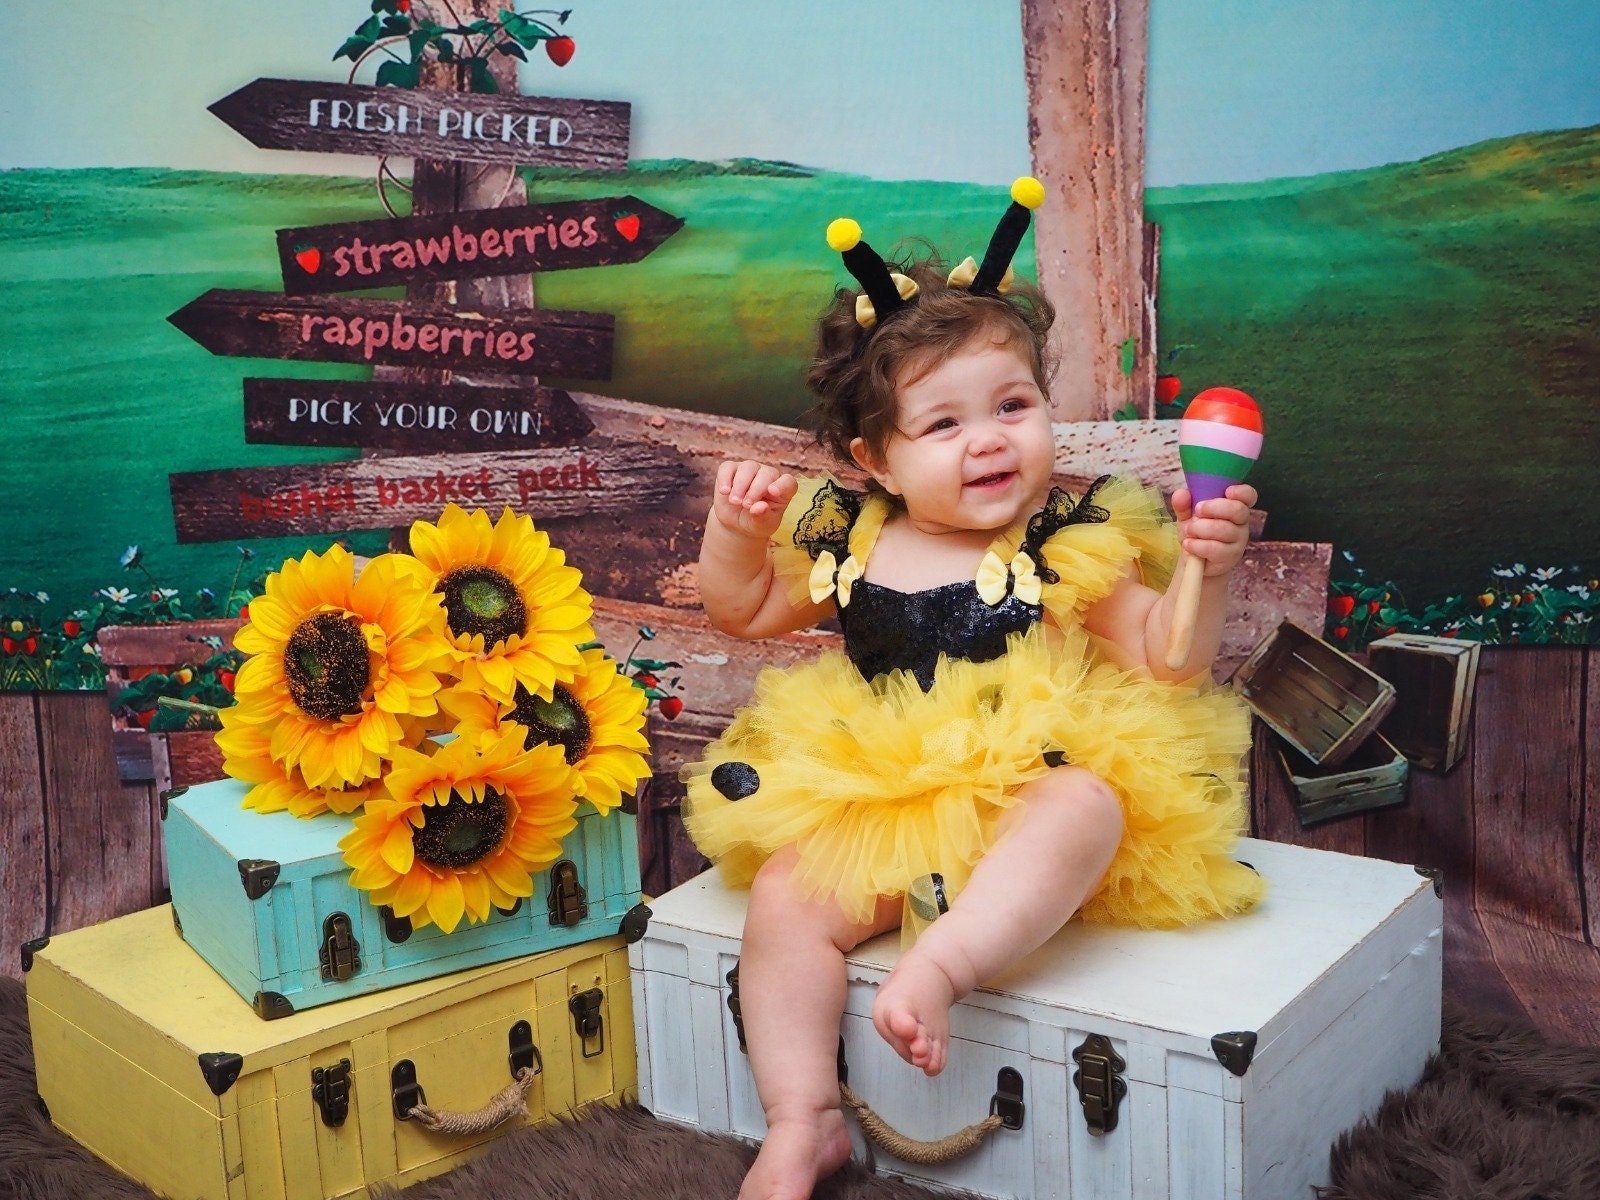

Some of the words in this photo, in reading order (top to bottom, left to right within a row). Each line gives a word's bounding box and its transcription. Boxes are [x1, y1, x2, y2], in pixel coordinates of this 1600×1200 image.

[310, 99, 421, 133] FRESH
[438, 108, 574, 147] PICKED
[333, 215, 599, 276] strawberries
[302, 314, 536, 361] raspberries
[288, 398, 364, 425] PICK
[377, 402, 458, 432] YOUR
[470, 407, 543, 436] OWN
[240, 481, 356, 523] bushel
[376, 467, 495, 506] basket
[518, 456, 602, 501] peck
